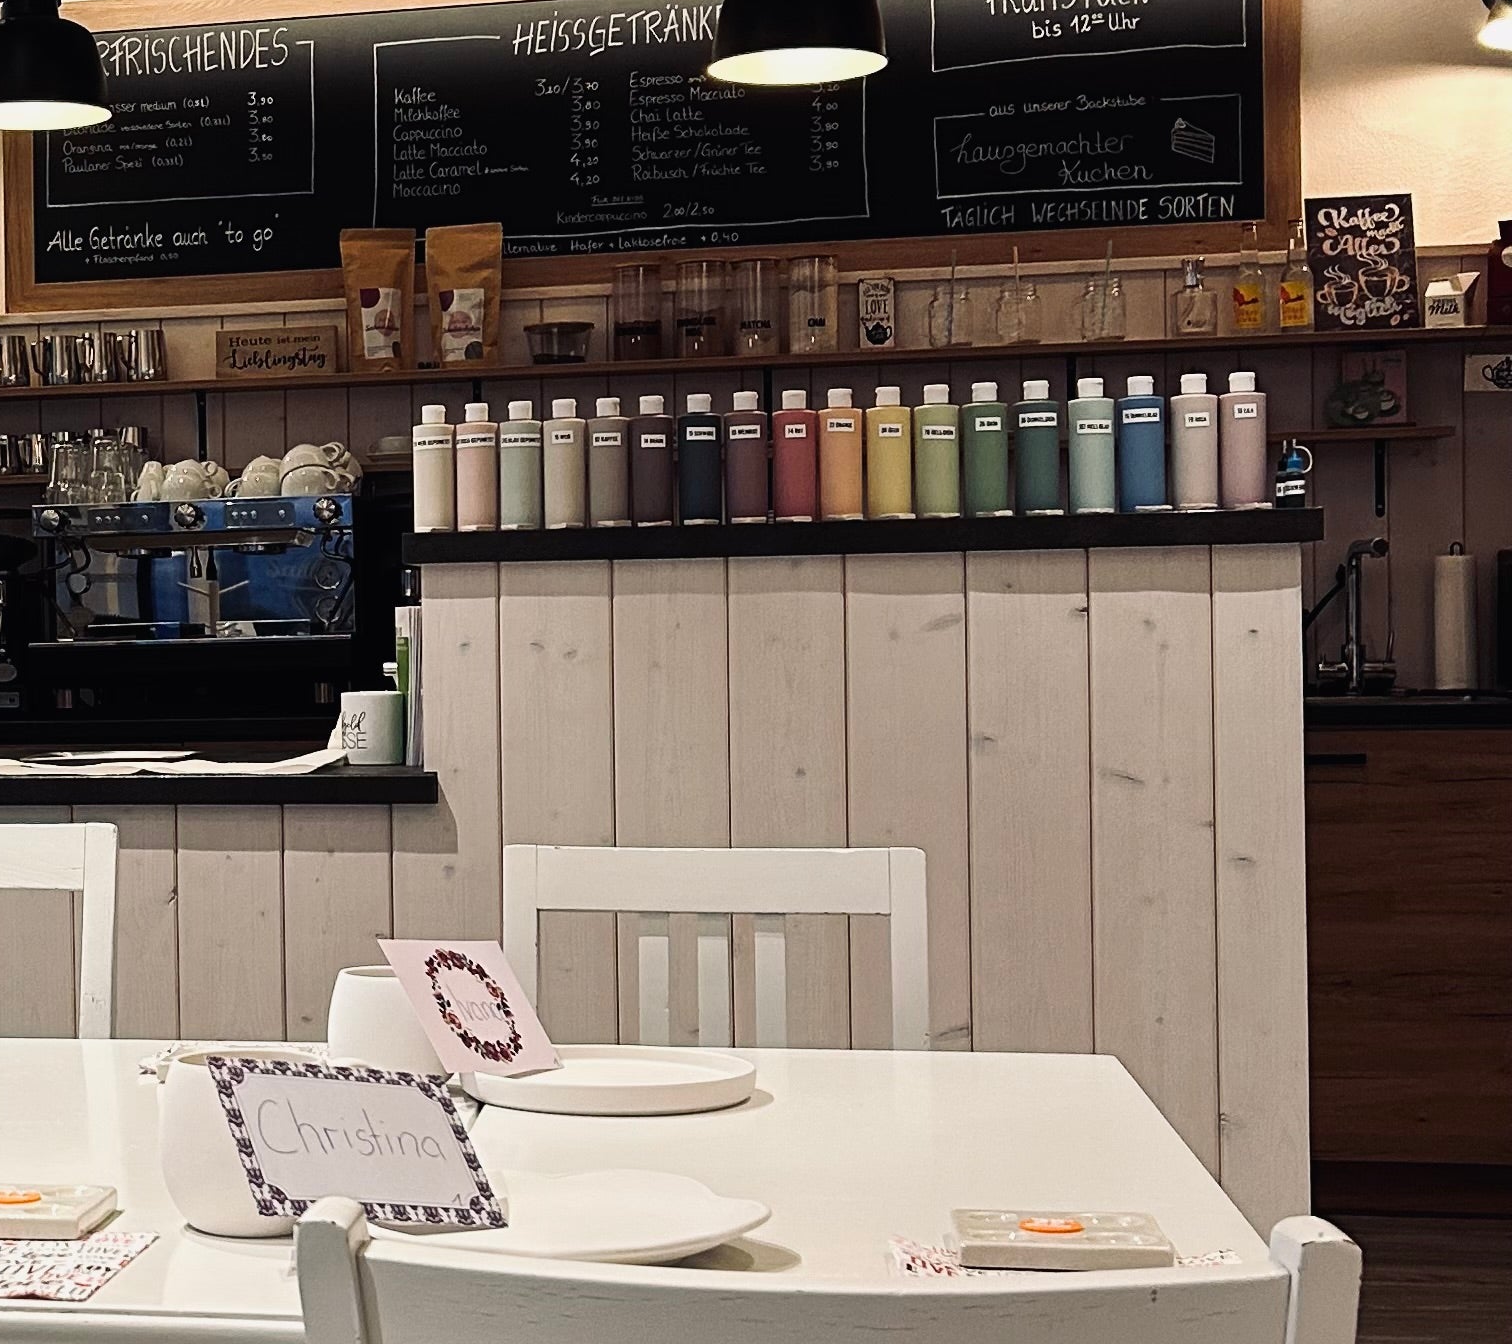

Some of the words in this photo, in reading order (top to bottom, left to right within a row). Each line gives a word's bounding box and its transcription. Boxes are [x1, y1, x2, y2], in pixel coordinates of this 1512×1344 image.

[1031, 18, 1062, 40] bis
[1107, 11, 1141, 32] Uhr
[99, 26, 289, 78] RFRISCHENDES
[629, 71, 684, 88] Espresso
[393, 87, 437, 105] Kaffee
[629, 89, 685, 107] Espresso
[140, 100, 177, 113] medium
[393, 105, 462, 124] Milchkaffee
[989, 104, 1015, 118] aus
[1023, 100, 1072, 114] unserer
[1076, 94, 1147, 112] Backstube
[630, 108, 662, 124] Chai
[392, 124, 463, 142] Cappuccino
[631, 126, 671, 143] Heiße
[673, 122, 751, 140] Schokolade
[62, 140, 114, 157] Orangina
[393, 143, 427, 161] Latte
[631, 144, 693, 163] Schwarzer
[739, 140, 763, 155] Tee
[951, 130, 1135, 175] hausgemachter
[62, 156, 113, 174] Paulaner
[114, 155, 144, 172] Spezi
[393, 163, 426, 182] Latte
[429, 160, 483, 179] Caramel
[745, 161, 768, 175] Tee
[1057, 159, 1154, 186] Kuchen
[556, 209, 648, 225] Kindercappuccino
[1031, 198, 1149, 225] WECHSELNDE
[1157, 192, 1235, 221] SORTEN
[1317, 202, 1401, 230] Kaffee
[46, 228, 84, 253] Alle
[88, 221, 164, 251] Getränke
[172, 225, 209, 247] auch
[570, 239, 605, 256] Hafer
[92, 253, 155, 266] Flaschenpfand
[228, 336, 272, 348] Heute
[223, 345, 327, 371] Lieblingstag
[257, 1096, 448, 1161] Christina
